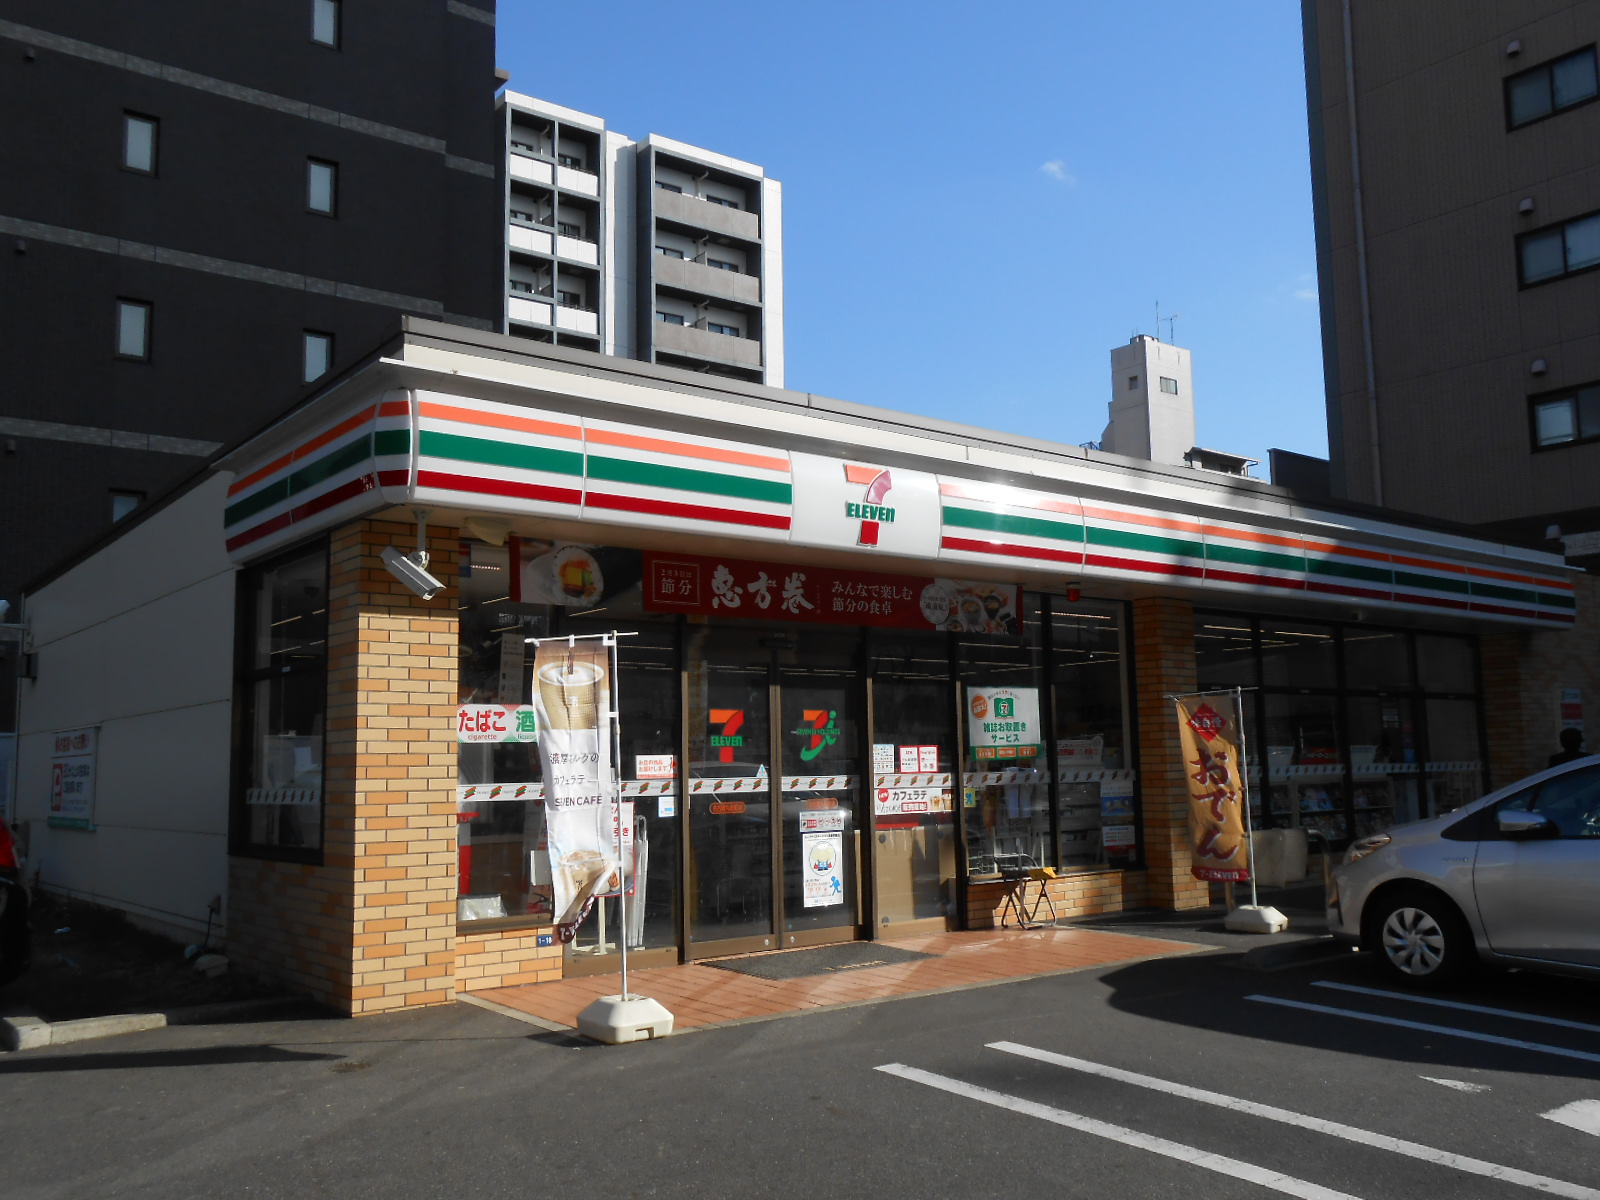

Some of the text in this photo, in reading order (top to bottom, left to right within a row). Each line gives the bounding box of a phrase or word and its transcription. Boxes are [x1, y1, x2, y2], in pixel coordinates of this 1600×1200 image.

[844, 464, 893, 546] 7
[661, 578, 693, 596] 節分
[831, 580, 914, 601] みんなで楽しむ
[832, 596, 893, 616] 節分の食卓
[458, 709, 507, 732] たばこ
[515, 710, 536, 732] 酒
[467, 733, 498, 741] cigarette
[709, 709, 745, 763] 7
[991, 733, 1020, 743] サービス
[553, 774, 586, 785] カフェラテ
[576, 793, 603, 806] CAFÉ
[892, 790, 928, 801] カフェラテ
[1188, 748, 1239, 862] おでん
